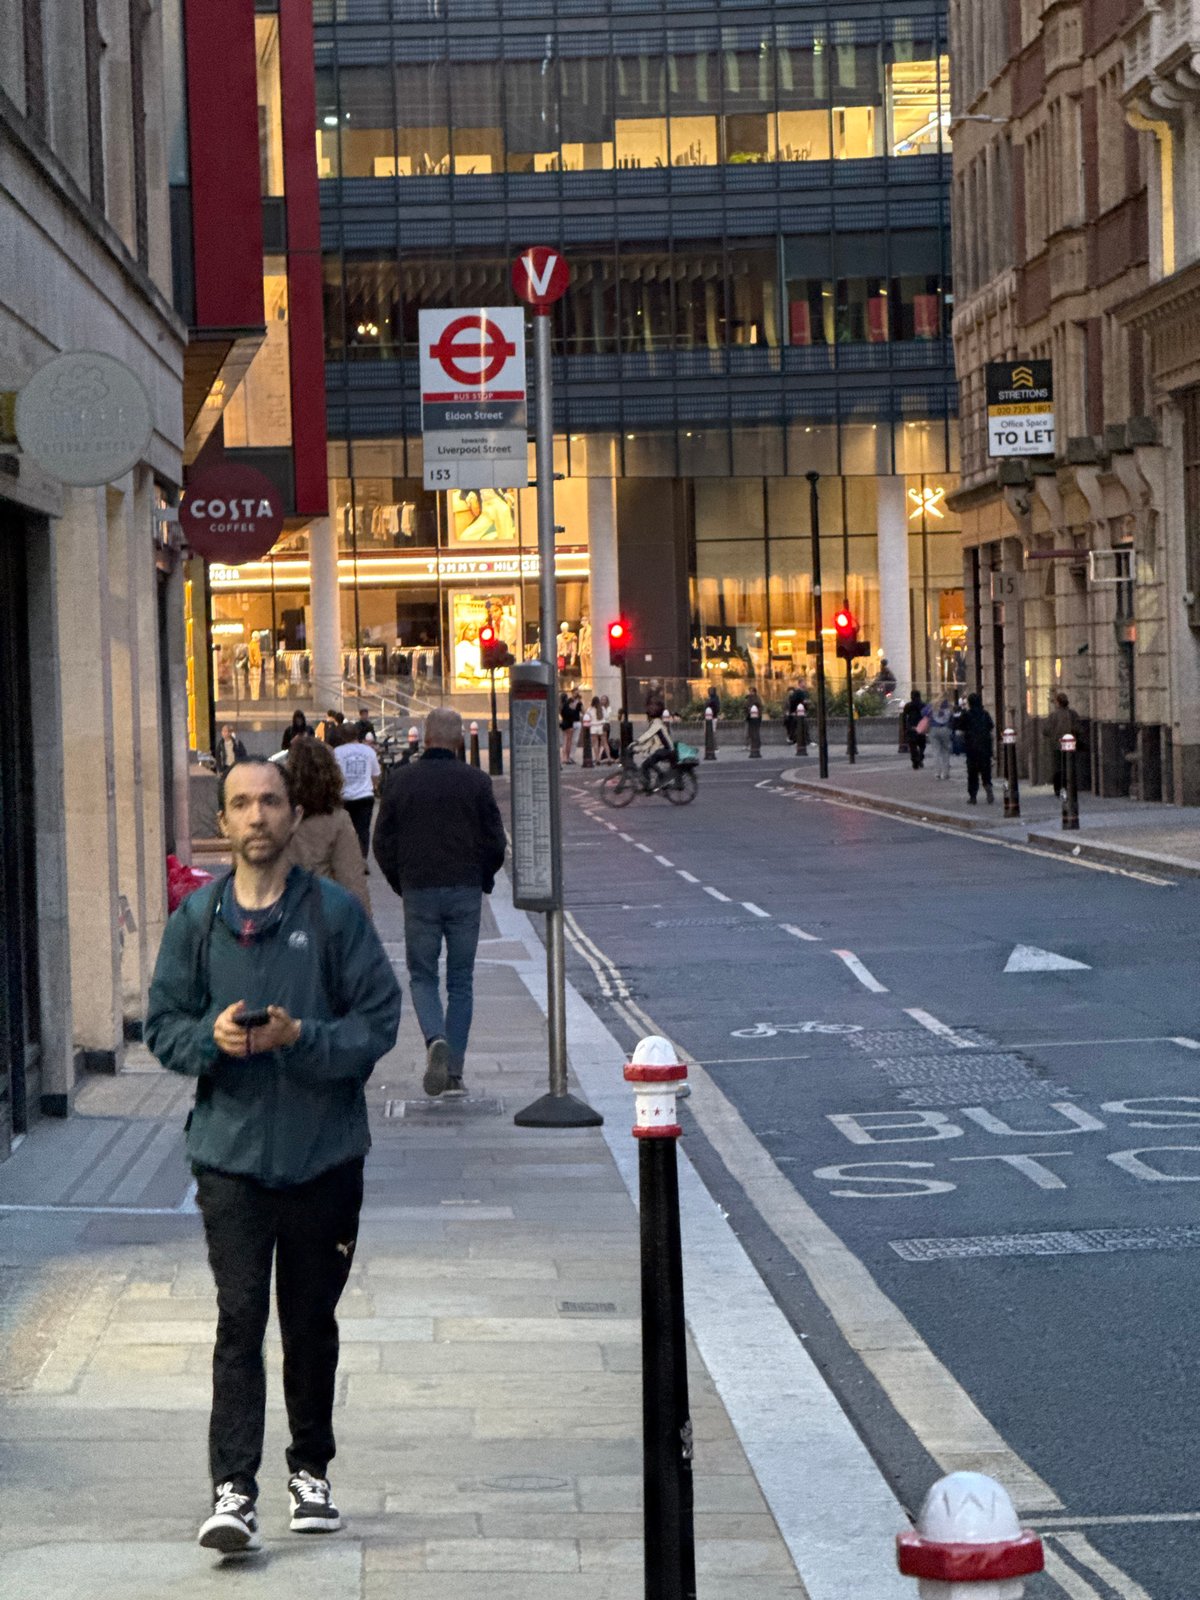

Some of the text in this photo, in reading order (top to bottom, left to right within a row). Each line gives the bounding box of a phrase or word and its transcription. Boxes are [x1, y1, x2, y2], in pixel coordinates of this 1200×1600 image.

[521, 255, 557, 296] V
[998, 388, 1048, 400] STRETTONS
[444, 410, 503, 421] Eldon Street
[1001, 418, 1048, 429] Office Space
[994, 429, 1055, 446] TO LET
[437, 444, 512, 456] Liverpool Street
[430, 469, 451, 480] 153
[190, 499, 273, 520] COSTA
[209, 523, 255, 533] COFFEE
[427, 562, 476, 573] TOMMY
[999, 577, 1014, 594] 15
[825, 1097, 1200, 1145] BUS
